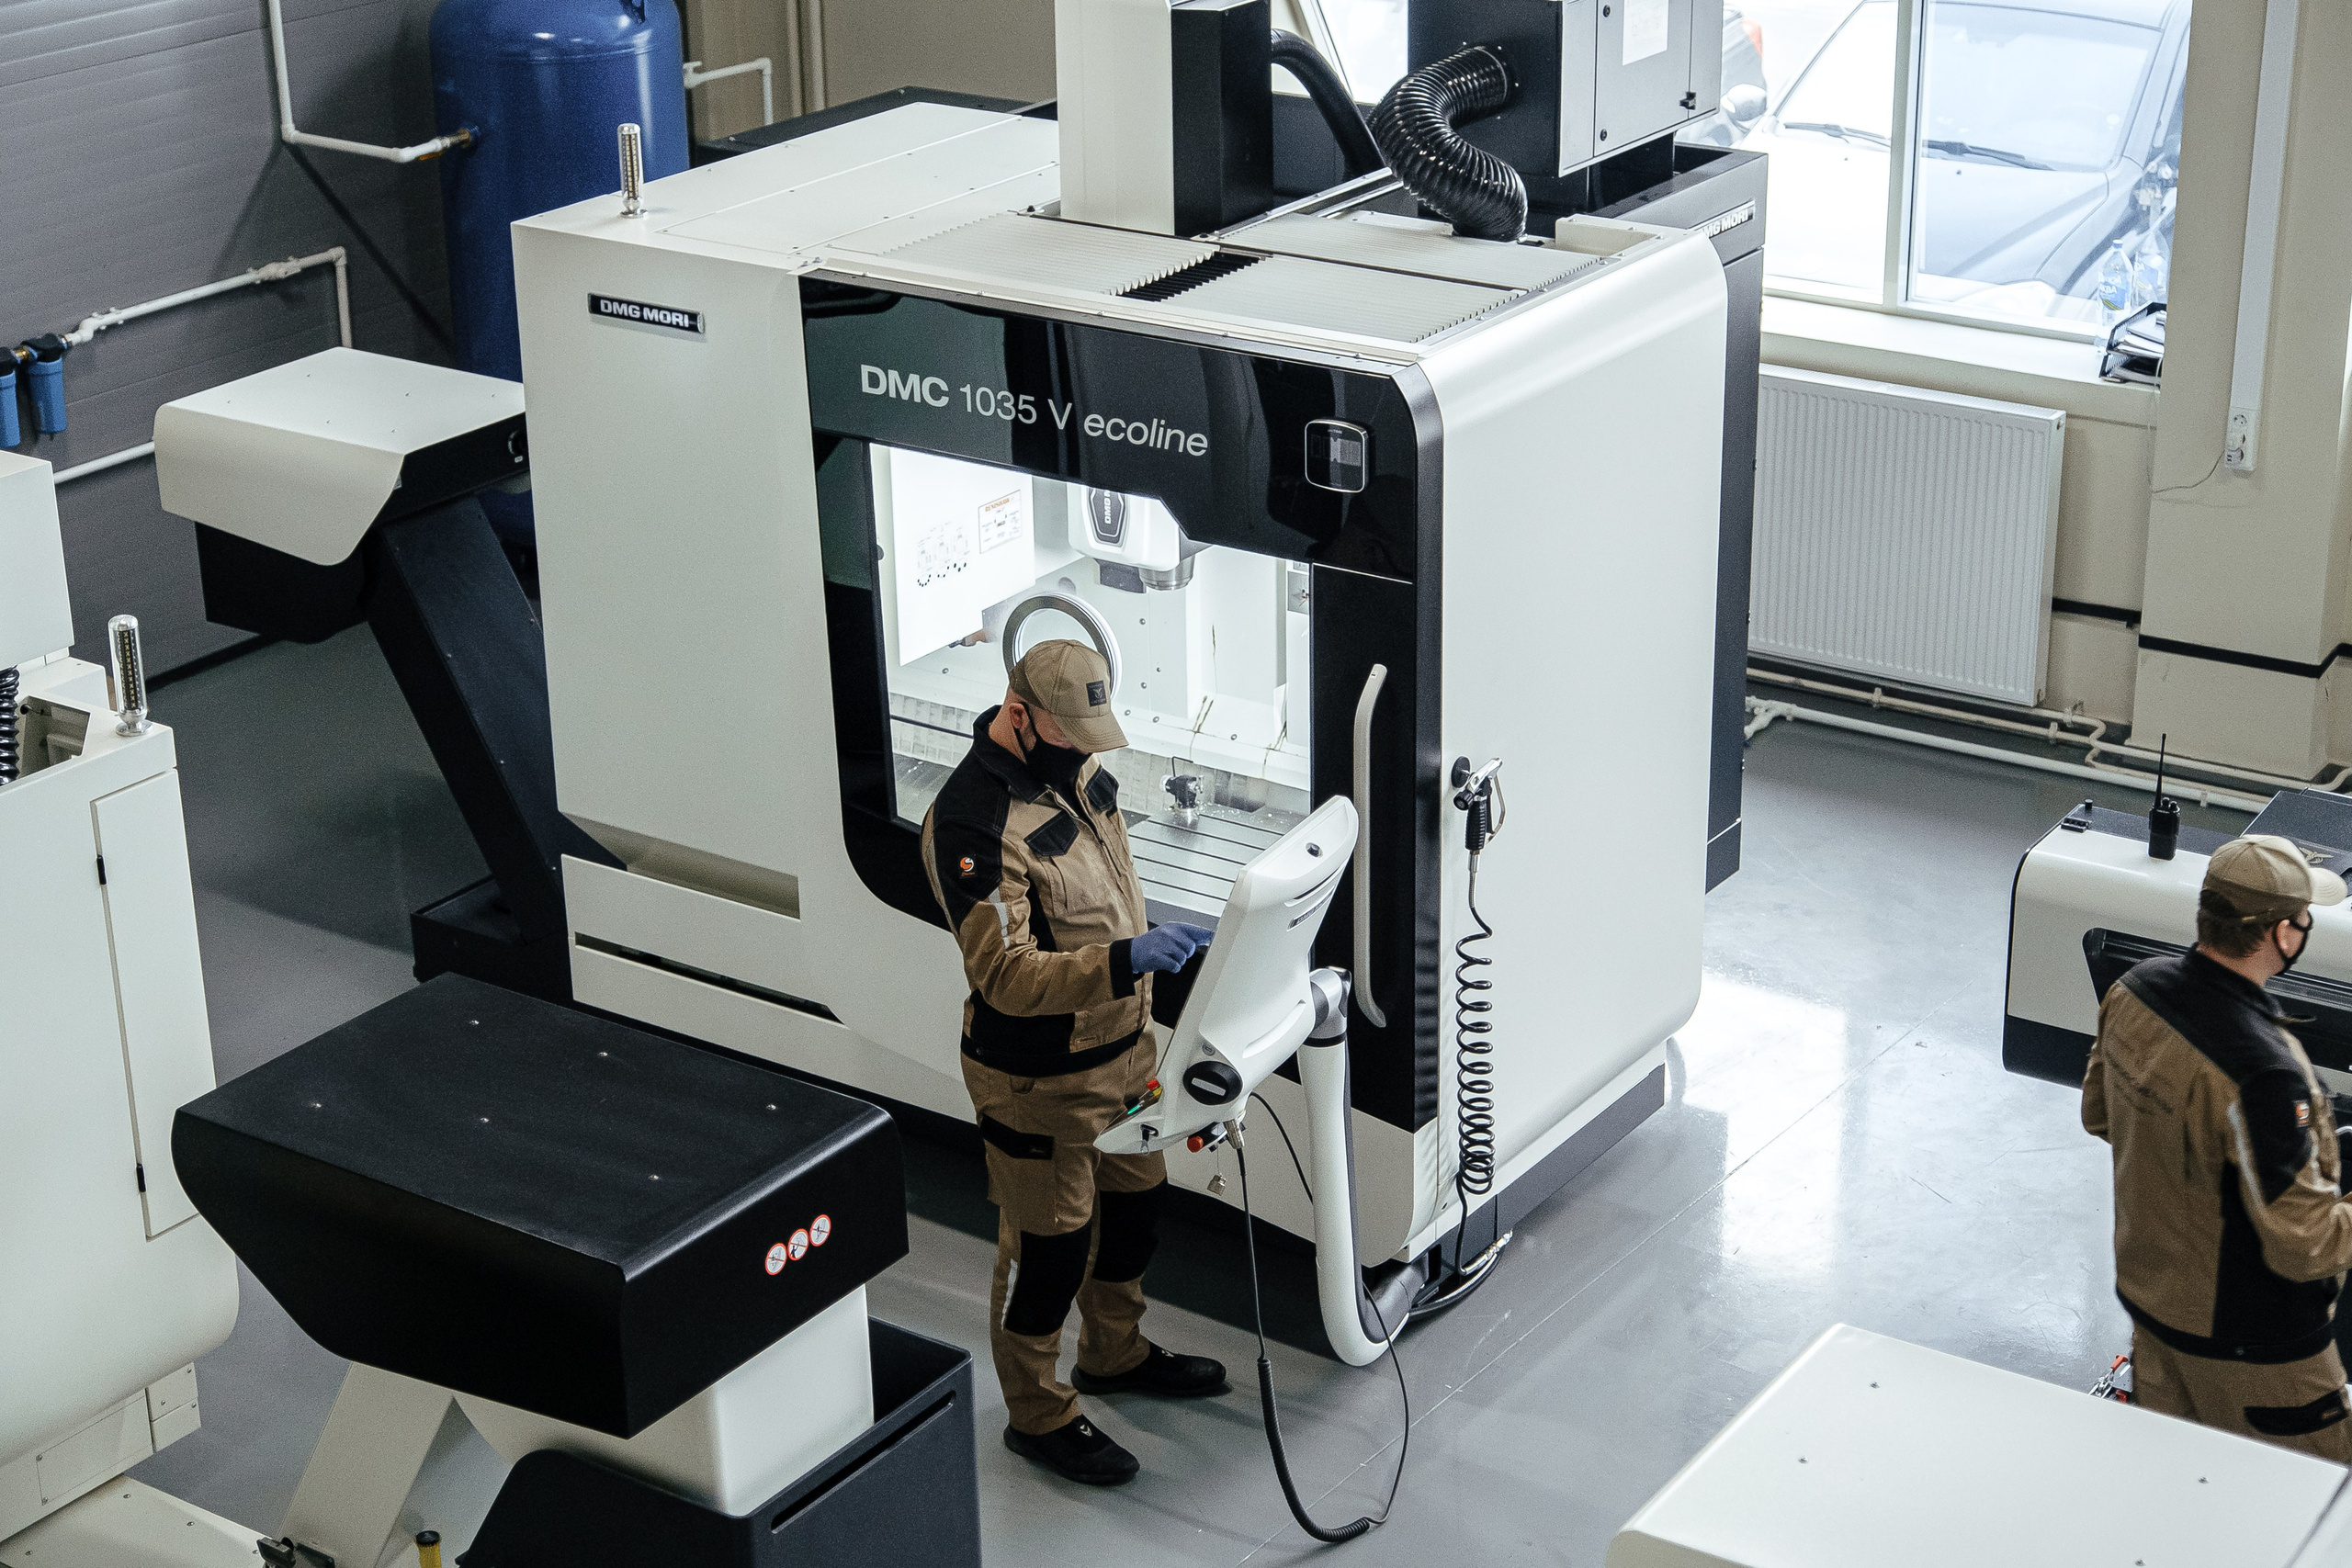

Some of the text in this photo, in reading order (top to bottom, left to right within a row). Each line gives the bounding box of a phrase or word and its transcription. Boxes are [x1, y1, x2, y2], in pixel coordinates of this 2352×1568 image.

[1702, 209, 1748, 237] MG MORI
[600, 299, 689, 328] DMG MORI
[860, 364, 1208, 457] DMC 1035 V ecoline
